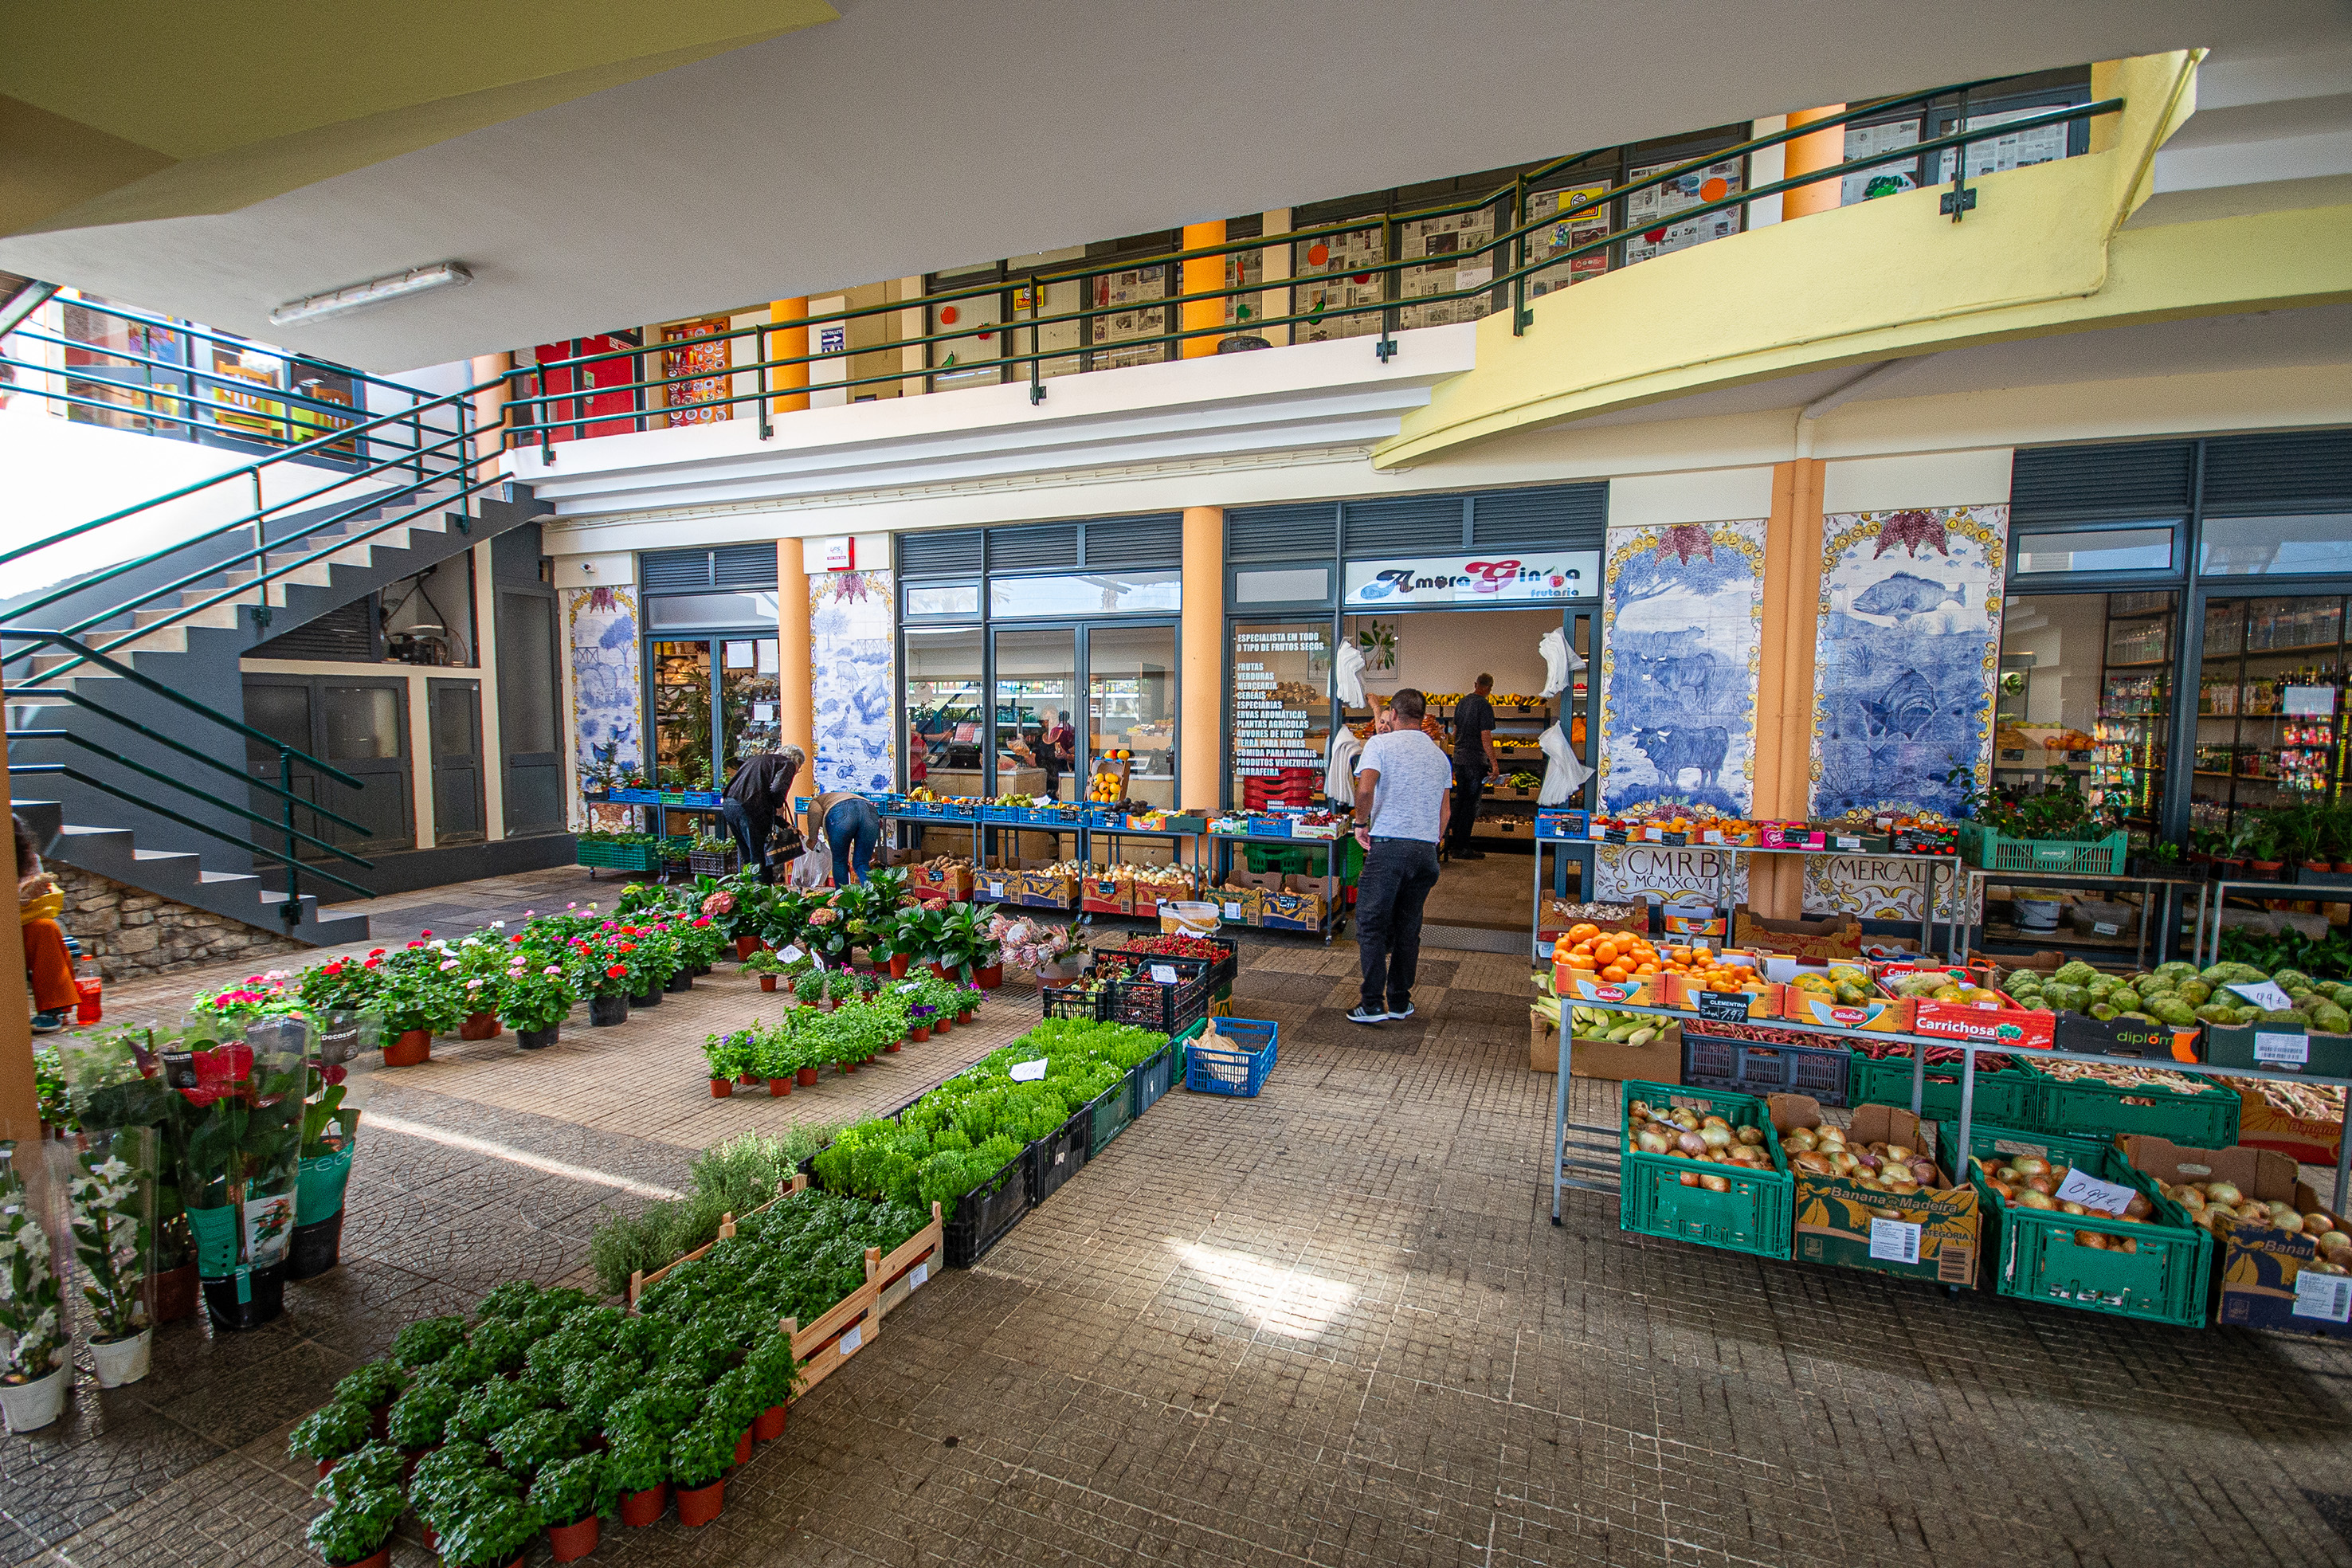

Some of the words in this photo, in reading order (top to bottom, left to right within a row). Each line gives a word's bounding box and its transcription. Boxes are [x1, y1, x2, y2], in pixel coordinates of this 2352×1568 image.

[1531, 587, 1579, 598] frutaria
[1237, 633, 1286, 642] ESPECIALISTA
[1287, 633, 1298, 641] EM
[1243, 643, 1260, 652] TIPO
[1260, 643, 1270, 652] DE
[1271, 642, 1299, 652] FRUTOS
[1299, 642, 1324, 651] SECOS
[1237, 700, 1283, 709] ESPECIARIAS
[1260, 709, 1307, 719] AROMÁTICAS
[1268, 719, 1309, 728] AGRÍCOLAS
[1237, 728, 1268, 738] ÁRVORES
[1280, 730, 1303, 739] FRUTO
[1280, 739, 1306, 748] FLORES
[1265, 749, 1285, 758] PARA
[1275, 759, 1329, 767] VENEZUELANOS
[1710, 999, 1747, 1009] CLEMENTINA
[1916, 1017, 1995, 1037] Carrichosa
[321, 1029, 357, 1041] Decorum
[1831, 1186, 1886, 1205] Banana
[1899, 1197, 1958, 1213] Madeira
[1921, 1227, 1970, 1241] ATEGORIA
